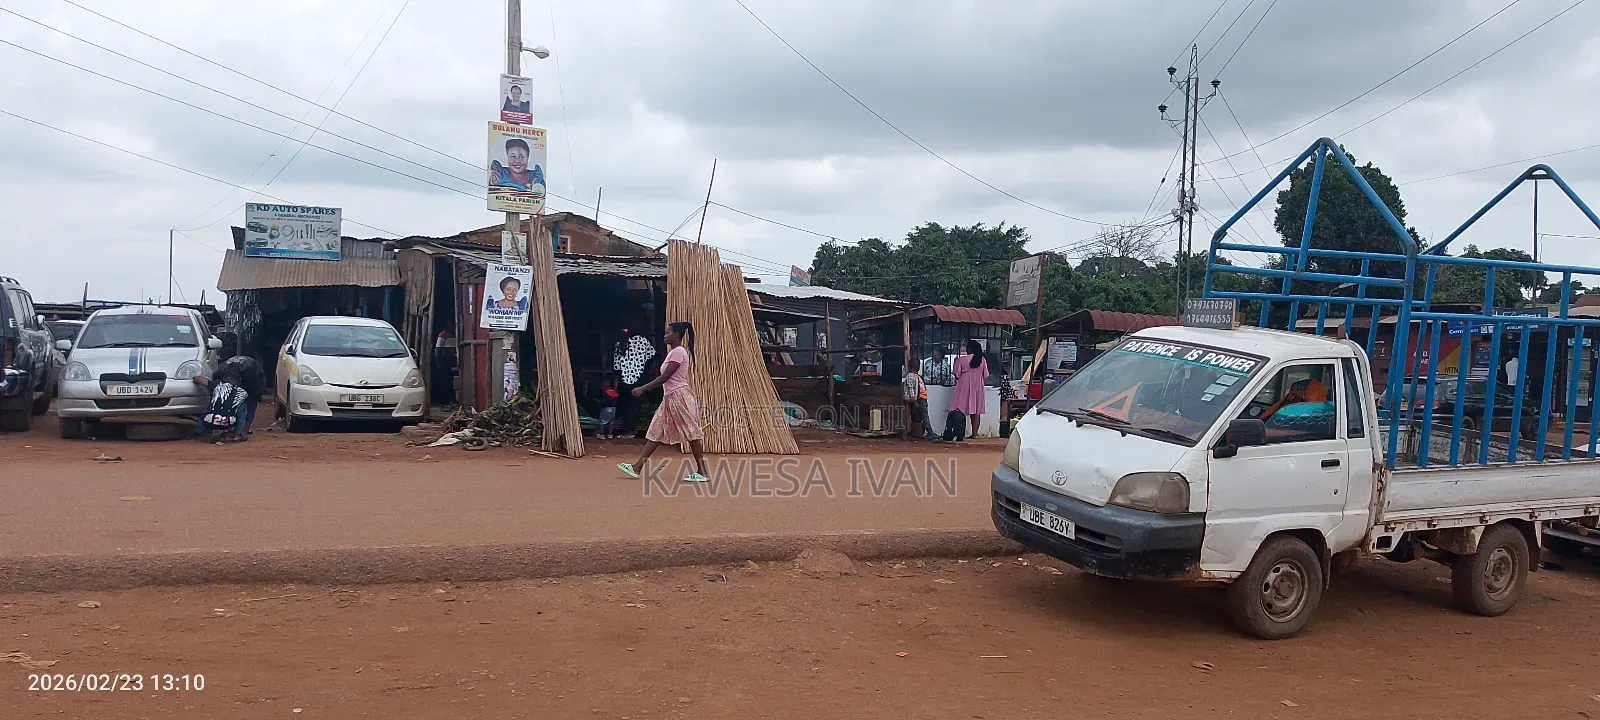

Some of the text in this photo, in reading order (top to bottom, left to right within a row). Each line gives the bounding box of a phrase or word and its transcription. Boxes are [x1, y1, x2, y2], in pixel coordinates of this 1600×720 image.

[496, 195, 541, 205] KITALA PARISH
[256, 204, 336, 216] KD AUTO SPARES
[494, 265, 531, 274] NABATANZI
[488, 308, 514, 316] WOMAN
[1121, 340, 1256, 373] PATIENCE IS POWER
[1444, 366, 1459, 374] MTN
[116, 385, 154, 394] UBD 142V
[1029, 507, 1070, 536] UBE 826Y
